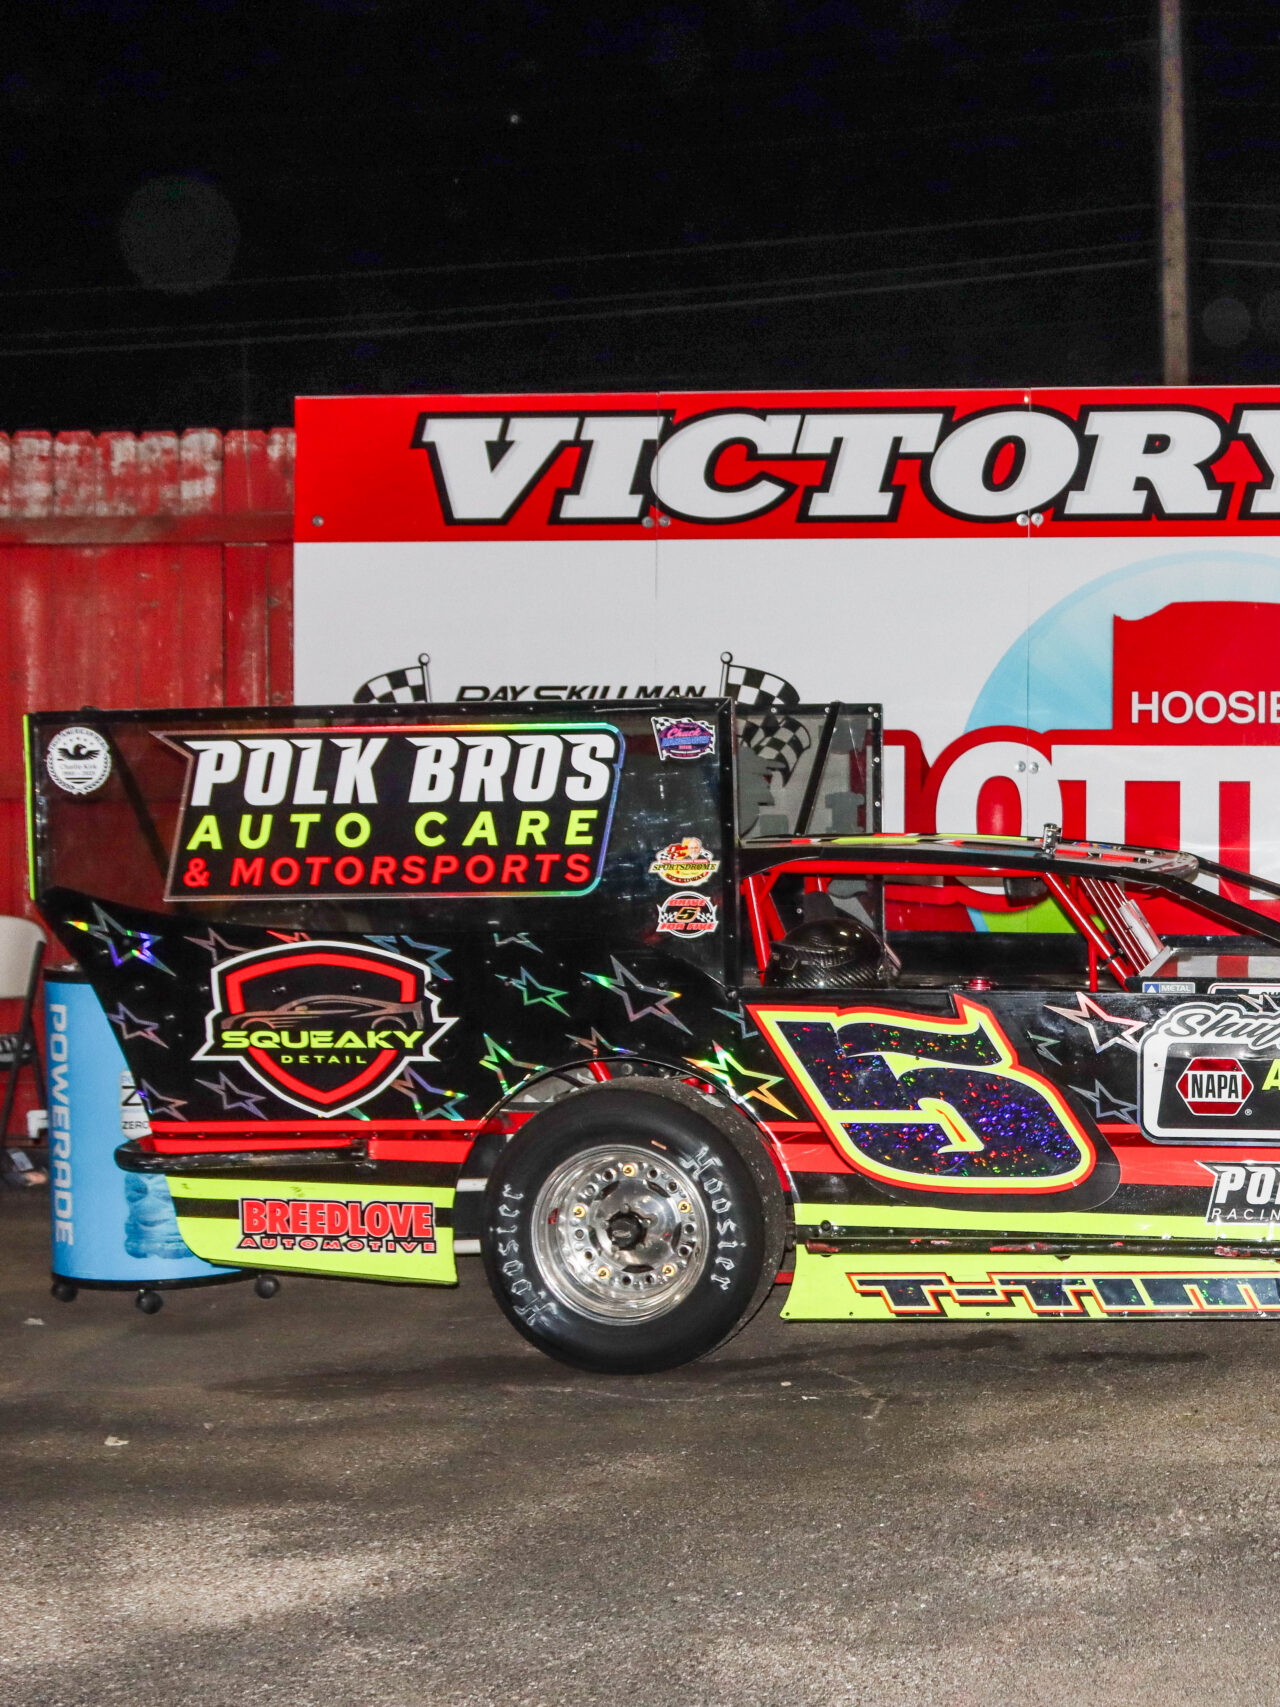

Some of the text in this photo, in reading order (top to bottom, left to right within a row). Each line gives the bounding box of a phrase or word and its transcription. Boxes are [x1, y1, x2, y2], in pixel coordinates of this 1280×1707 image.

[183, 734, 616, 807] POLK BROS
[186, 809, 599, 850] AUTO CARE
[183, 852, 592, 887] & MOTORSPORTS
[652, 863, 717, 871] SPORTSDROME
[667, 898, 706, 906] DRIVE
[1160, 984, 1191, 993] METAL
[222, 1030, 424, 1049] SQUEAKY
[280, 1055, 367, 1064] DETAIL
[750, 996, 1095, 1192] 5
[1191, 1074, 1241, 1100] NAPA
[50, 1003, 75, 1246] POWERADE
[241, 1199, 434, 1238] BREEDLOVE
[237, 1236, 437, 1254] AUTOMOTIVE
